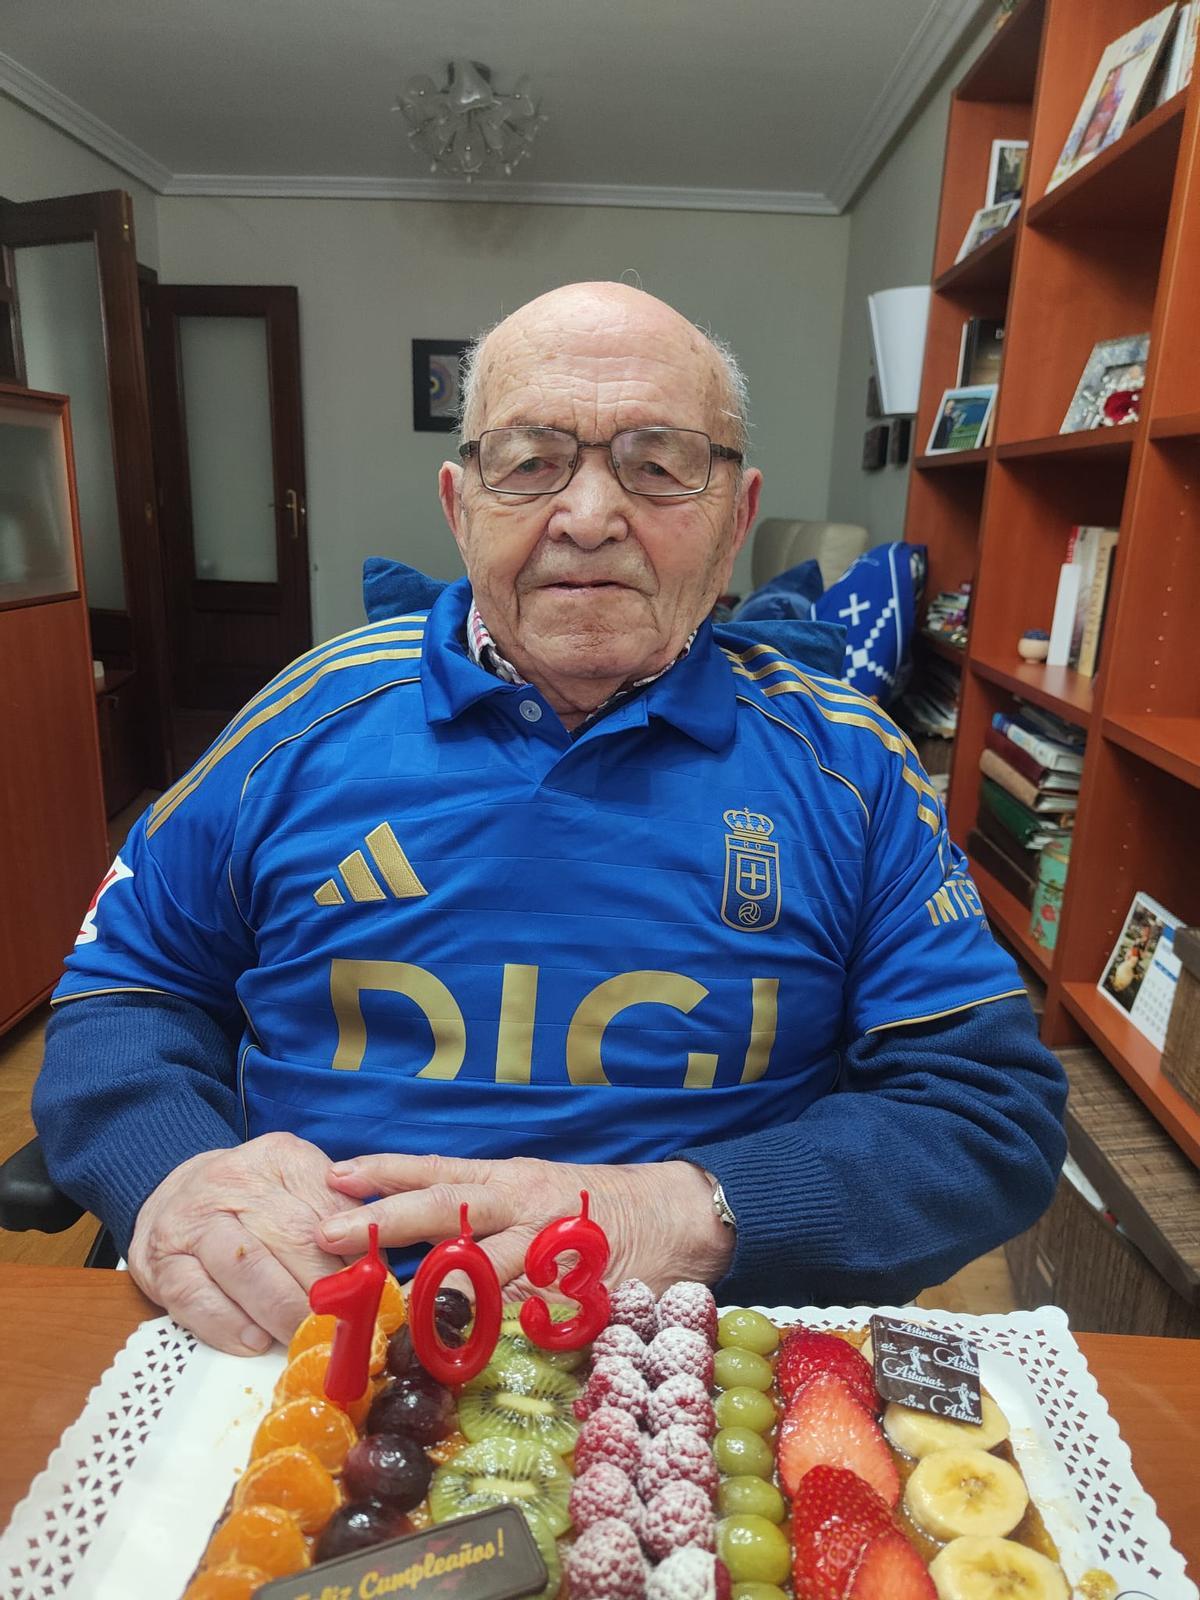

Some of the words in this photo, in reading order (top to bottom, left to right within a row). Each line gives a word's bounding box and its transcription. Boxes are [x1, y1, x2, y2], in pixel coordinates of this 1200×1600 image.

[329, 958, 780, 1089] DIGI
[309, 1212, 611, 1403] 103
[882, 1357, 945, 1390] Asturias
[358, 1527, 504, 1600] Cumpleaños!
